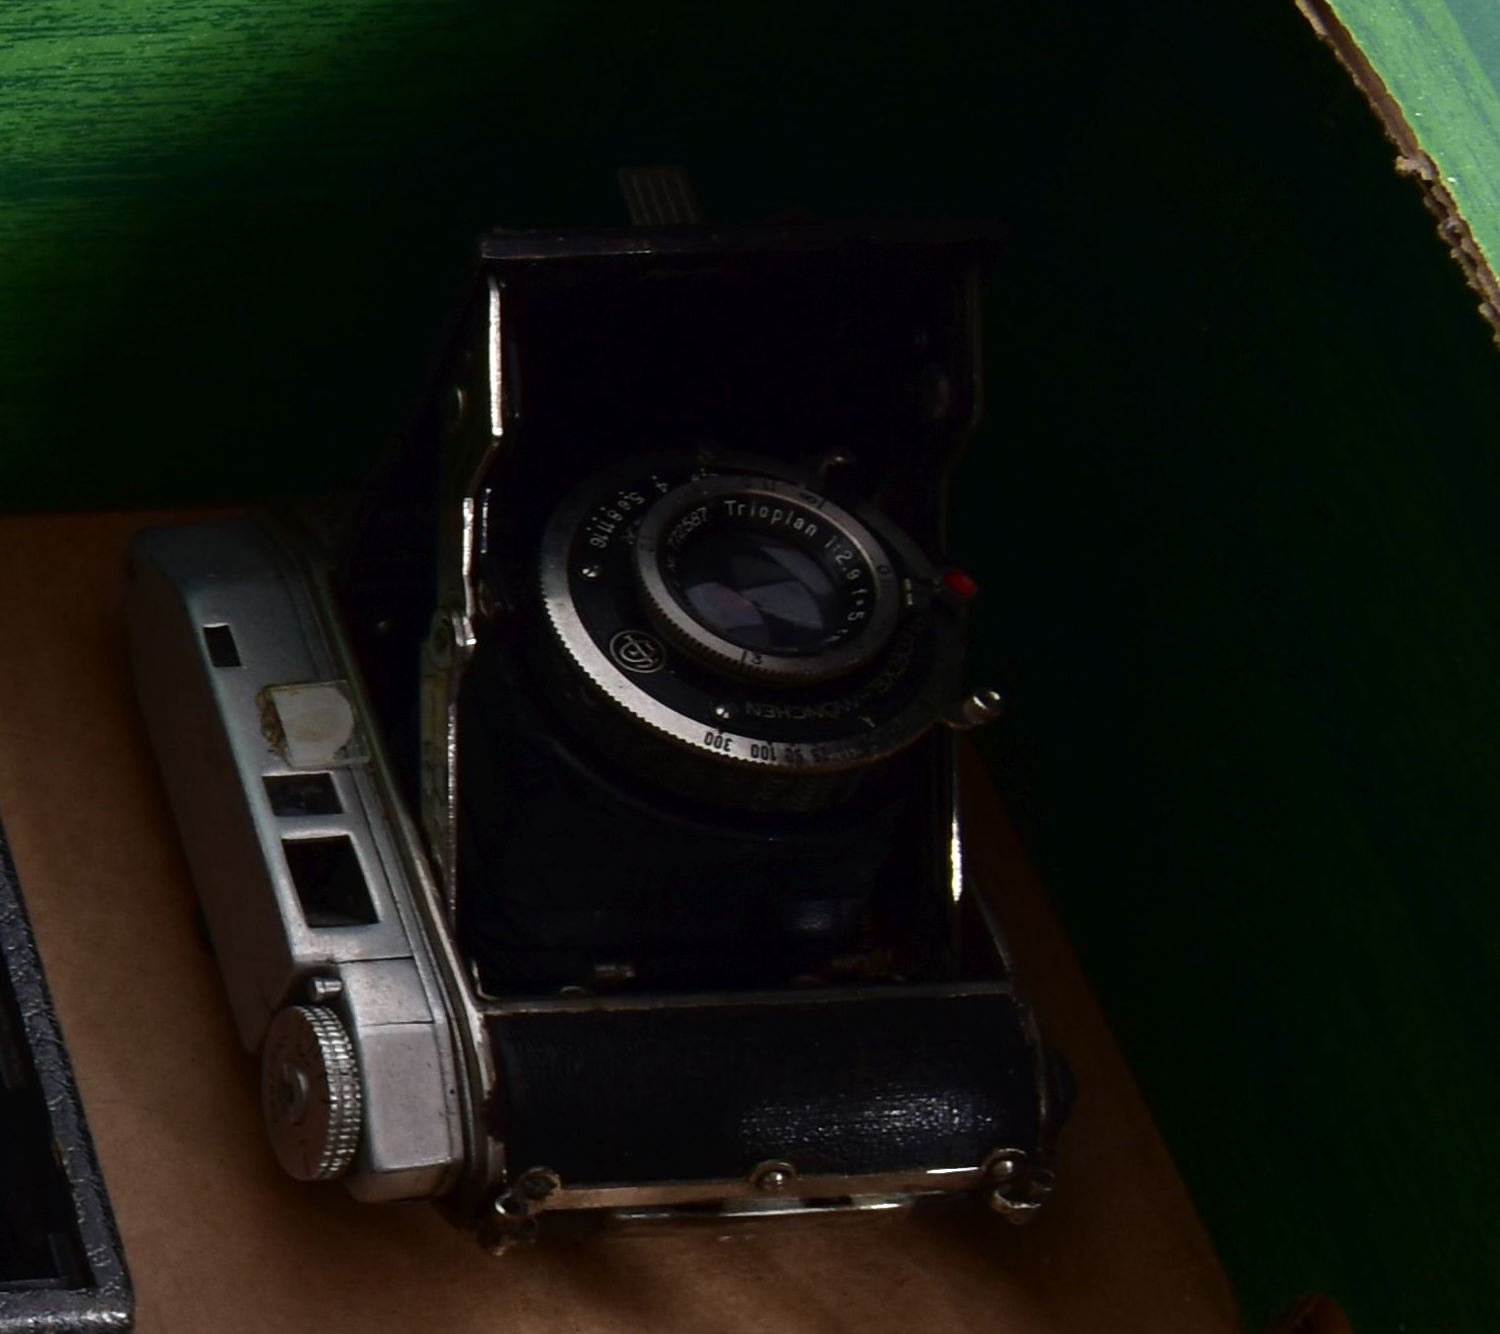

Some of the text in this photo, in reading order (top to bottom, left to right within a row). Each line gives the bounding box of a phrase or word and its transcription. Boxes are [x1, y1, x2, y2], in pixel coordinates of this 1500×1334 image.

[723, 498, 819, 538] Trioplan
[703, 732, 733, 752] 300
[751, 744, 777, 762] 100
